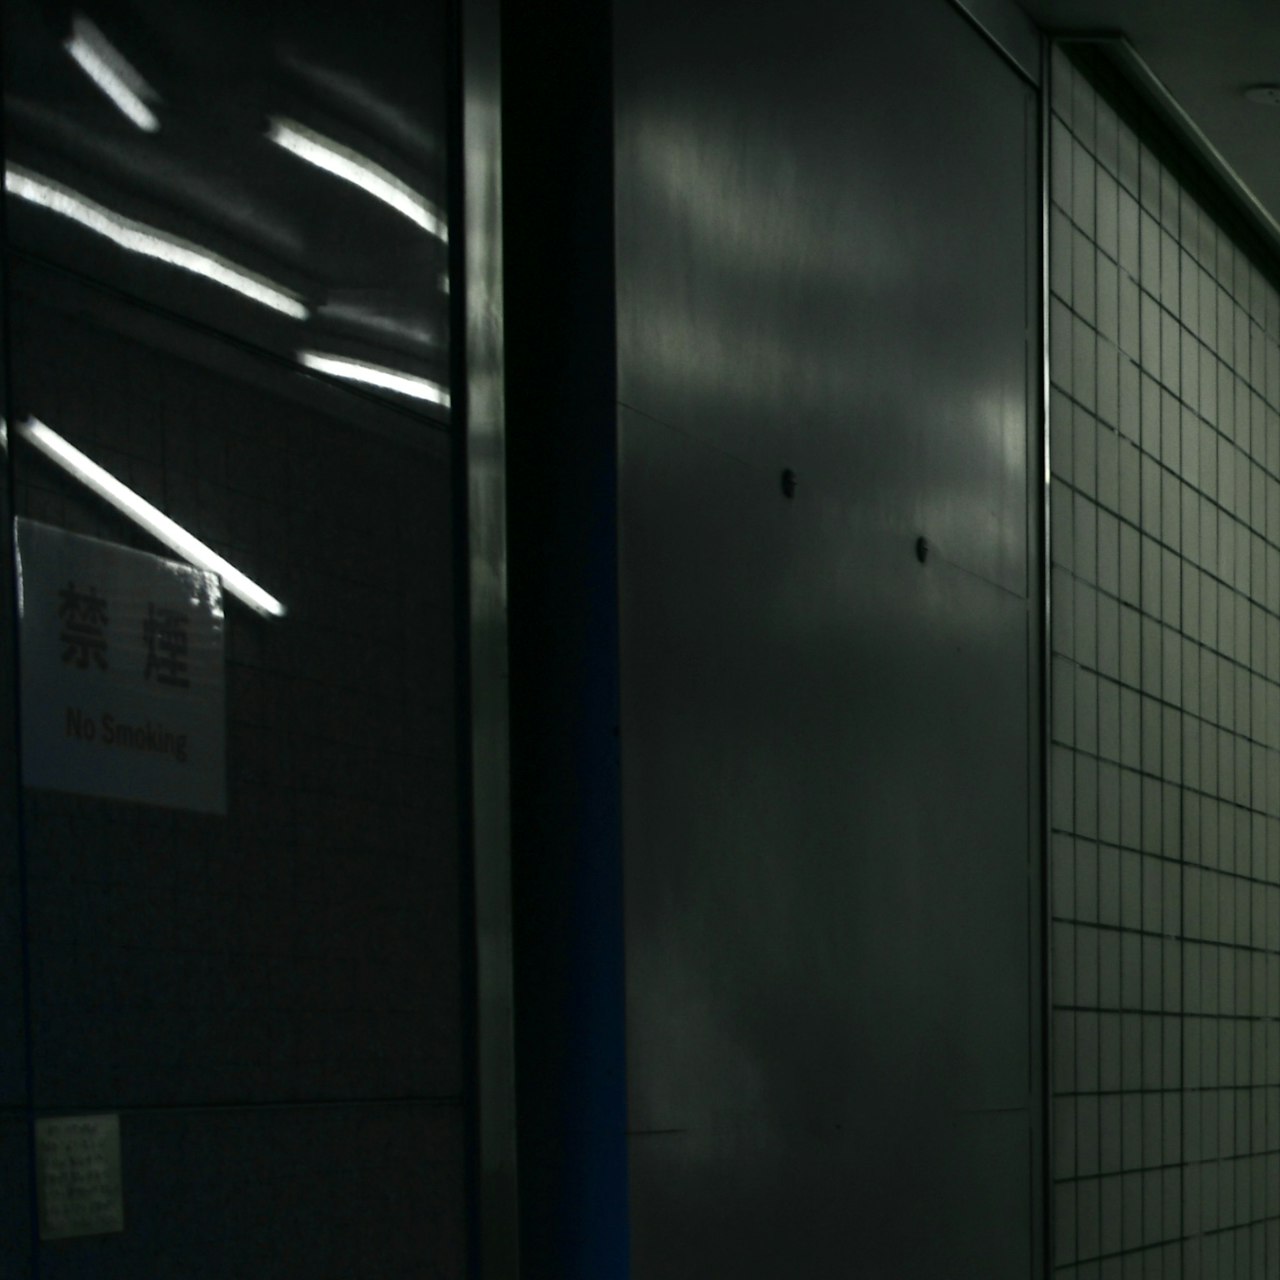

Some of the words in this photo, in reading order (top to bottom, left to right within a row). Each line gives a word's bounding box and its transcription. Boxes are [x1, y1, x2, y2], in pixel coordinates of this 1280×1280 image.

[58, 581, 191, 689] 禁煙
[65, 706, 96, 740] No
[102, 715, 189, 763] Smoking
